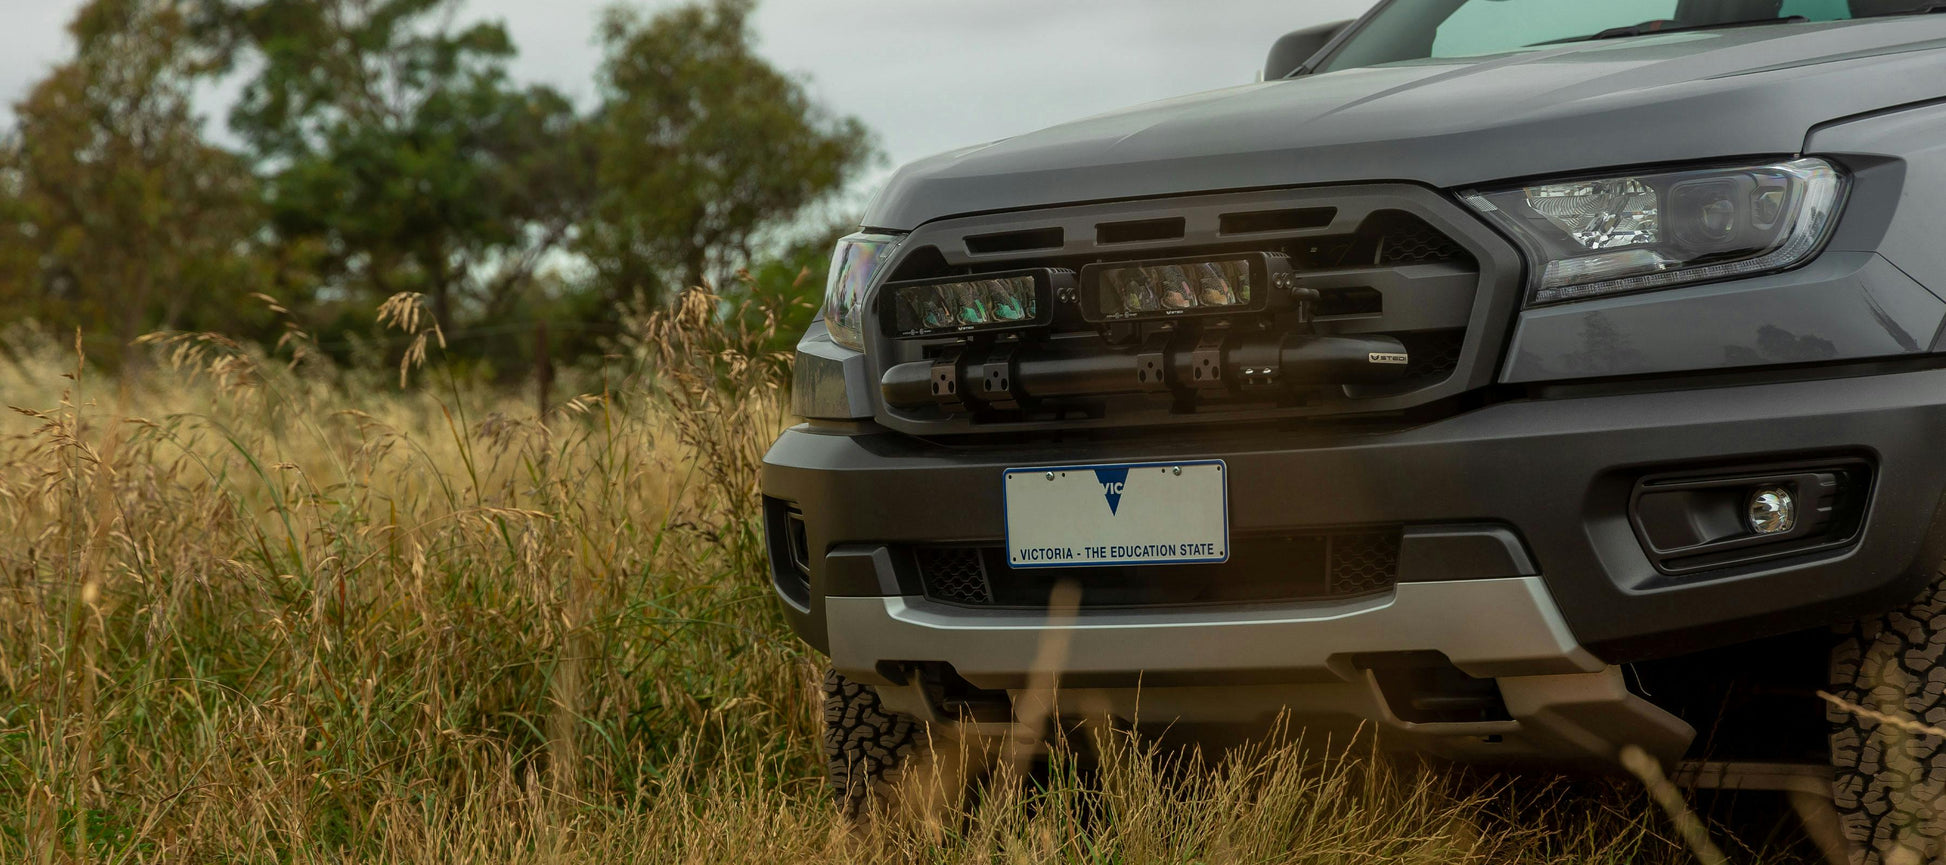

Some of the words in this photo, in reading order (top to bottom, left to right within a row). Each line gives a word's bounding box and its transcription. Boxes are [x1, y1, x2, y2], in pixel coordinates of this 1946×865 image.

[1101, 482, 1123, 495] VIC
[1020, 547, 1073, 561] VICTORIA
[1085, 547, 1107, 559] THE
[1111, 545, 1176, 558] EDUCATION
[1180, 543, 1214, 556] STATE
